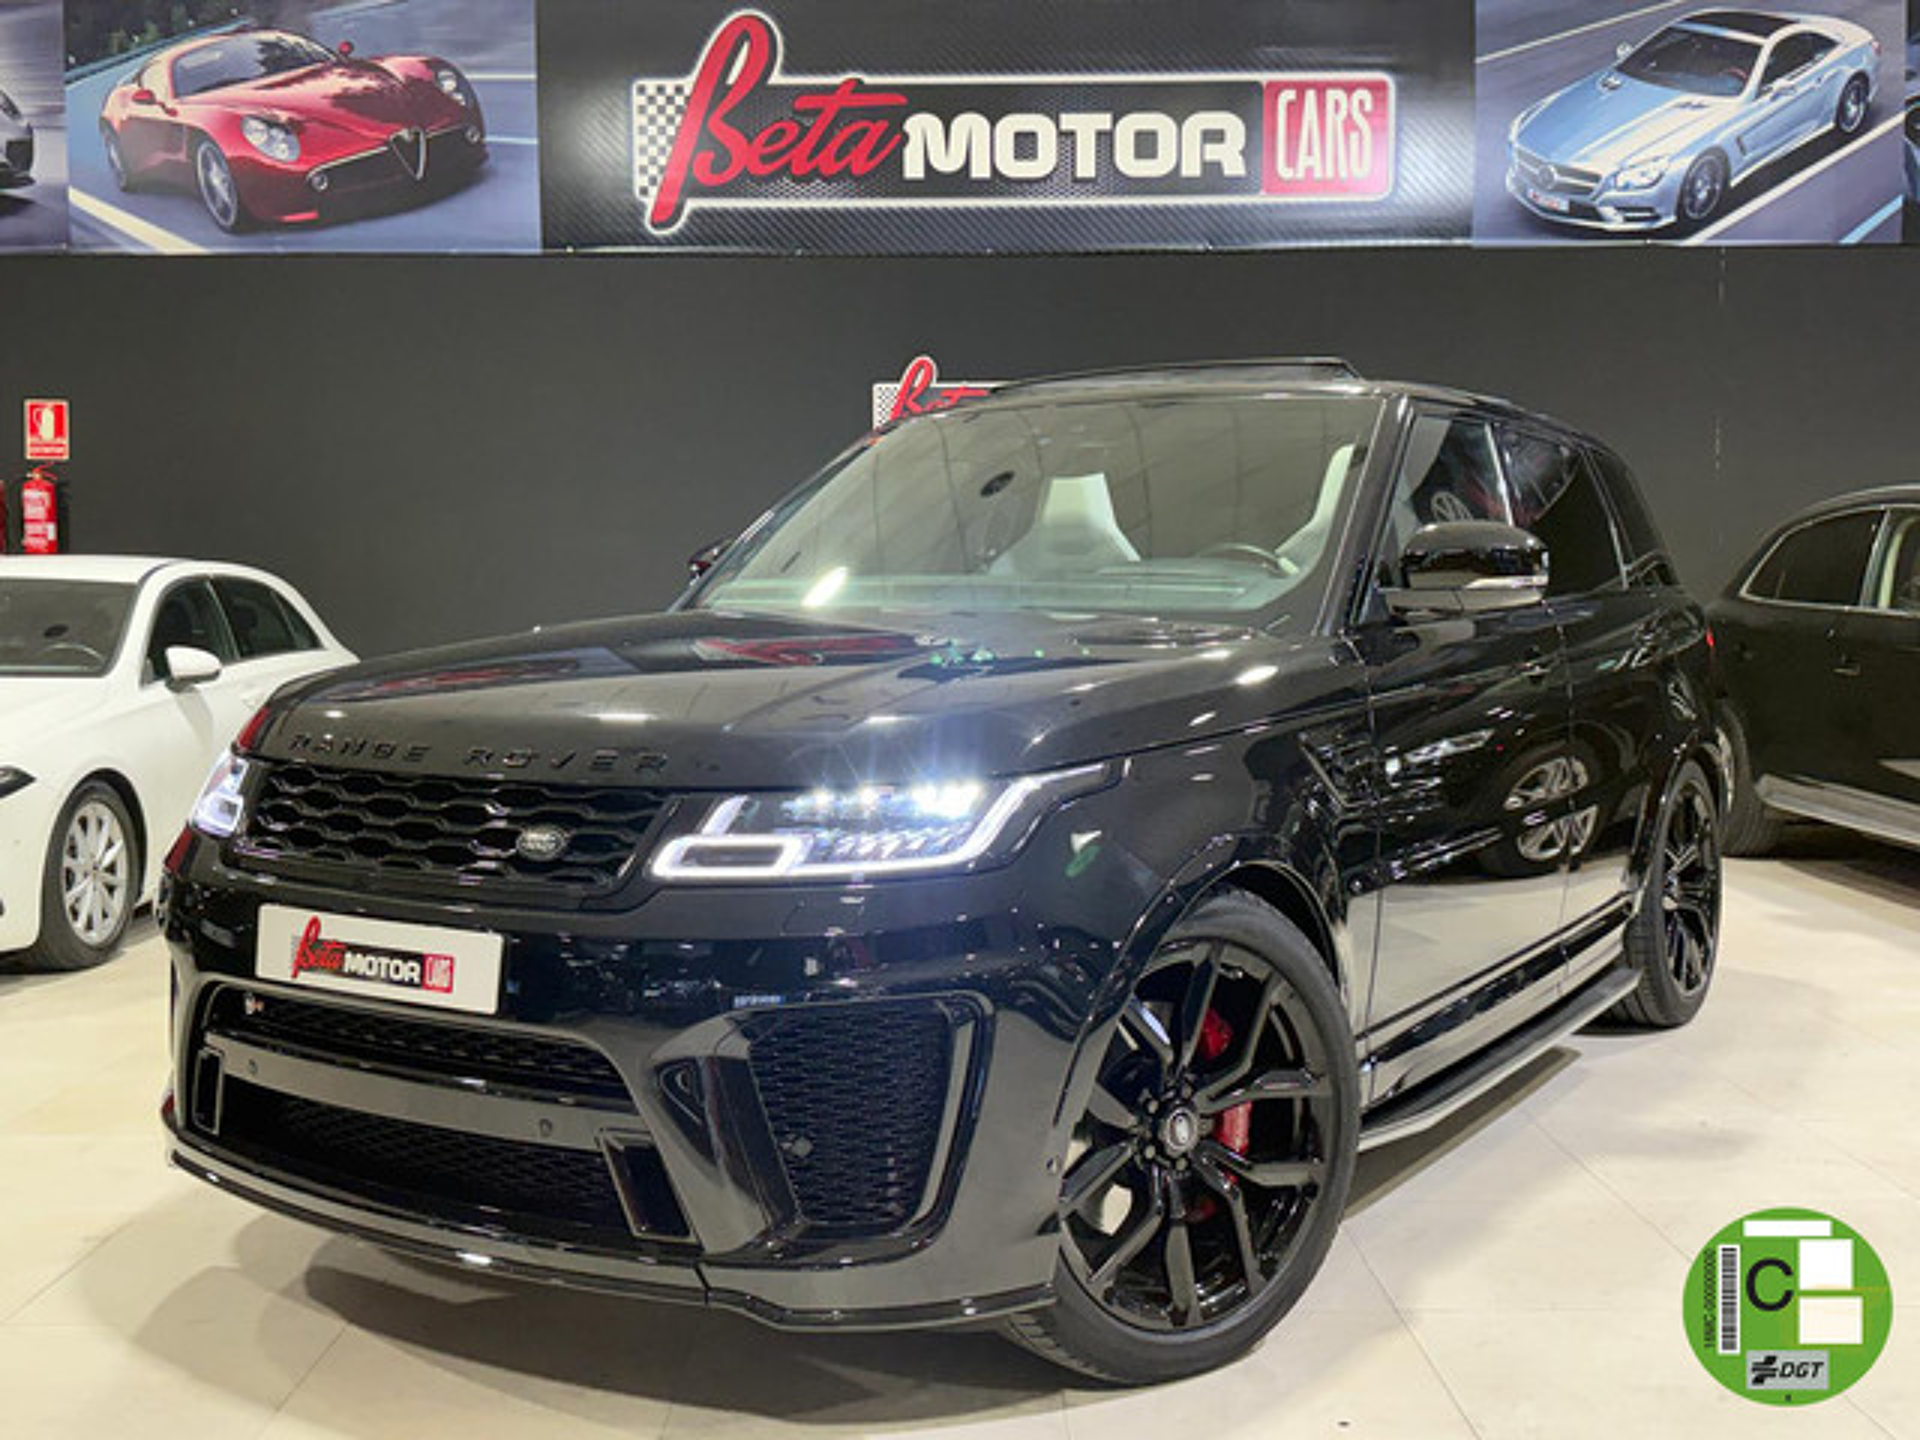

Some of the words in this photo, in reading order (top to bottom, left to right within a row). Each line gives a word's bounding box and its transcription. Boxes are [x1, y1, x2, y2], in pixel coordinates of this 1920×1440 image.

[651, 14, 909, 224] Beta
[902, 111, 1246, 180] MOTOR
[1275, 89, 1373, 182] CARS
[287, 733, 431, 763] RANGE
[463, 746, 669, 773] ROVER
[344, 951, 421, 985] MOTOR
